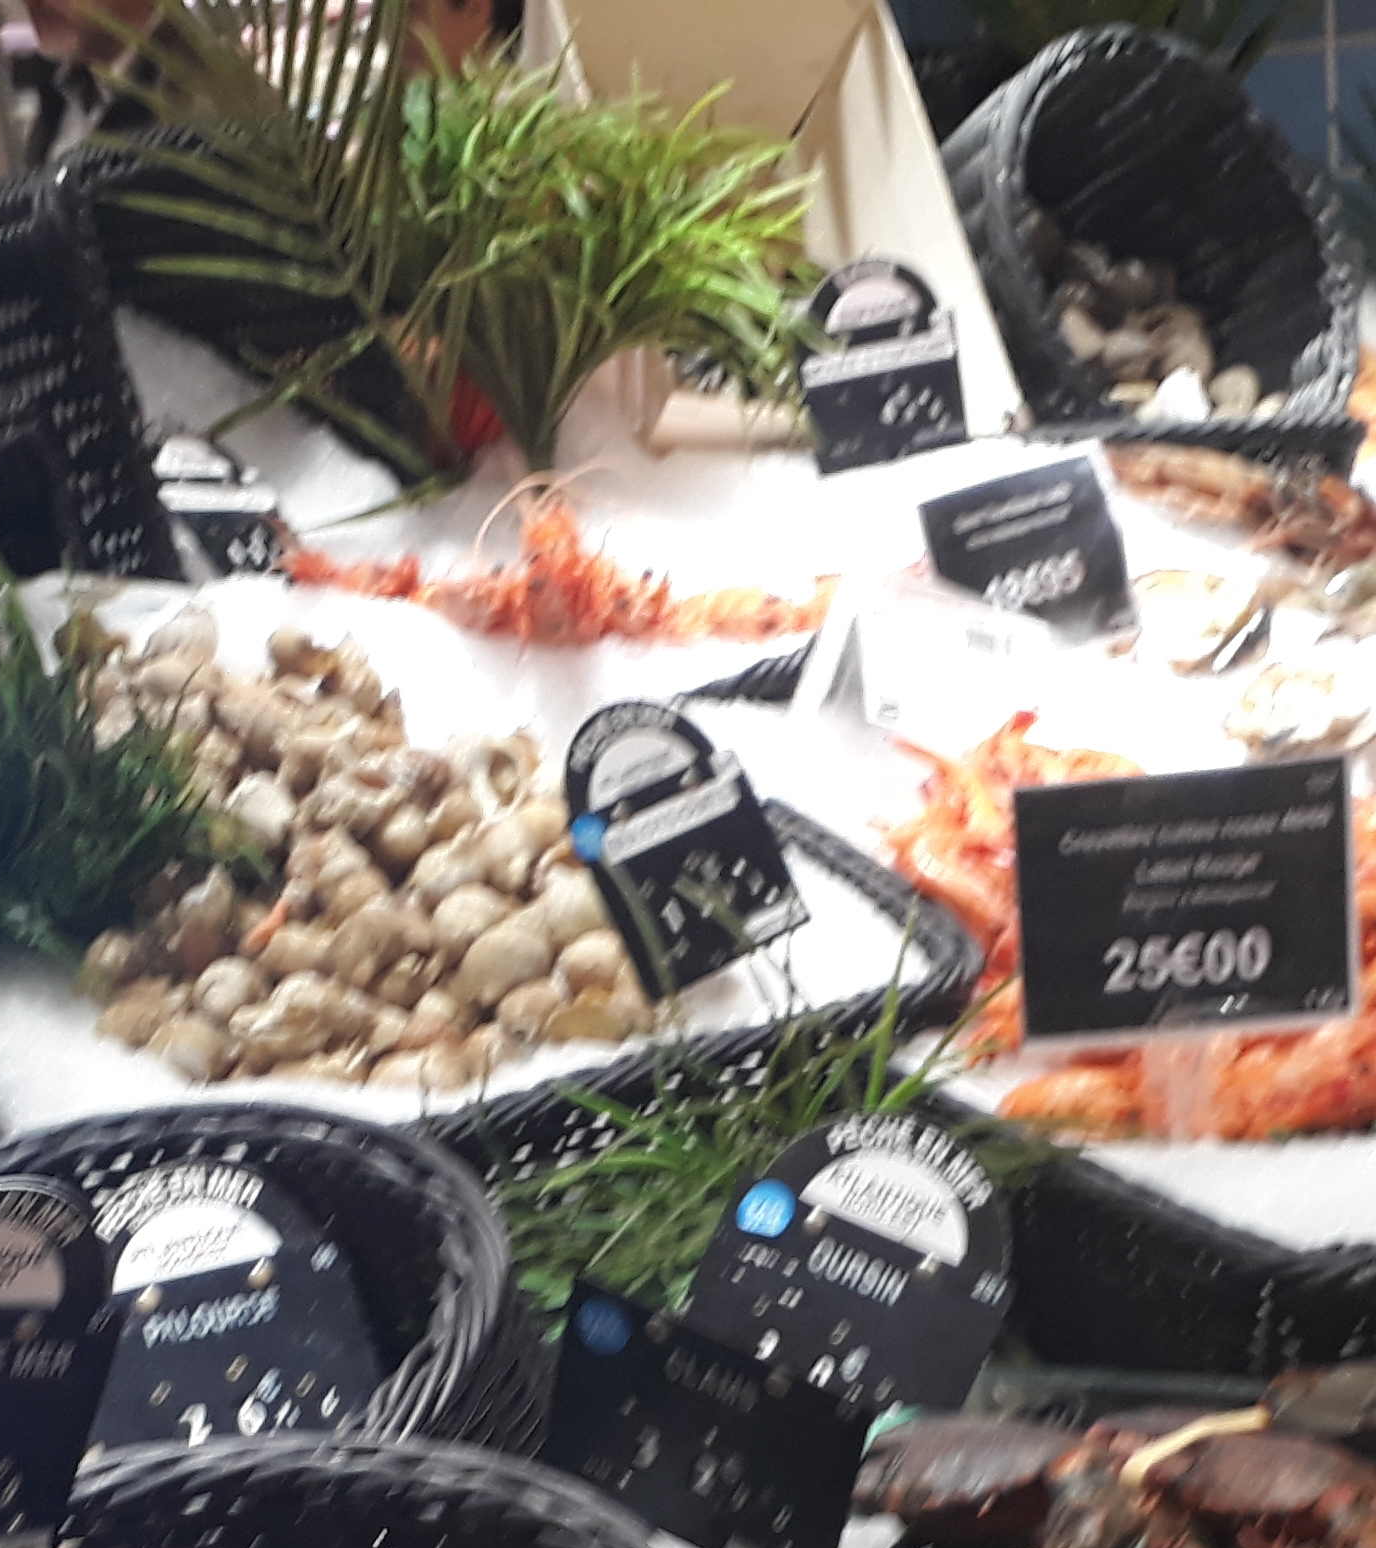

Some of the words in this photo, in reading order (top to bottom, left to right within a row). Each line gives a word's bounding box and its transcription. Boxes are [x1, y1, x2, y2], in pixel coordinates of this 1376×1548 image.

[1101, 922, 1275, 996] 25€00
[806, 1235, 911, 1308] OURSIN
[9, 1336, 77, 1380] MER
